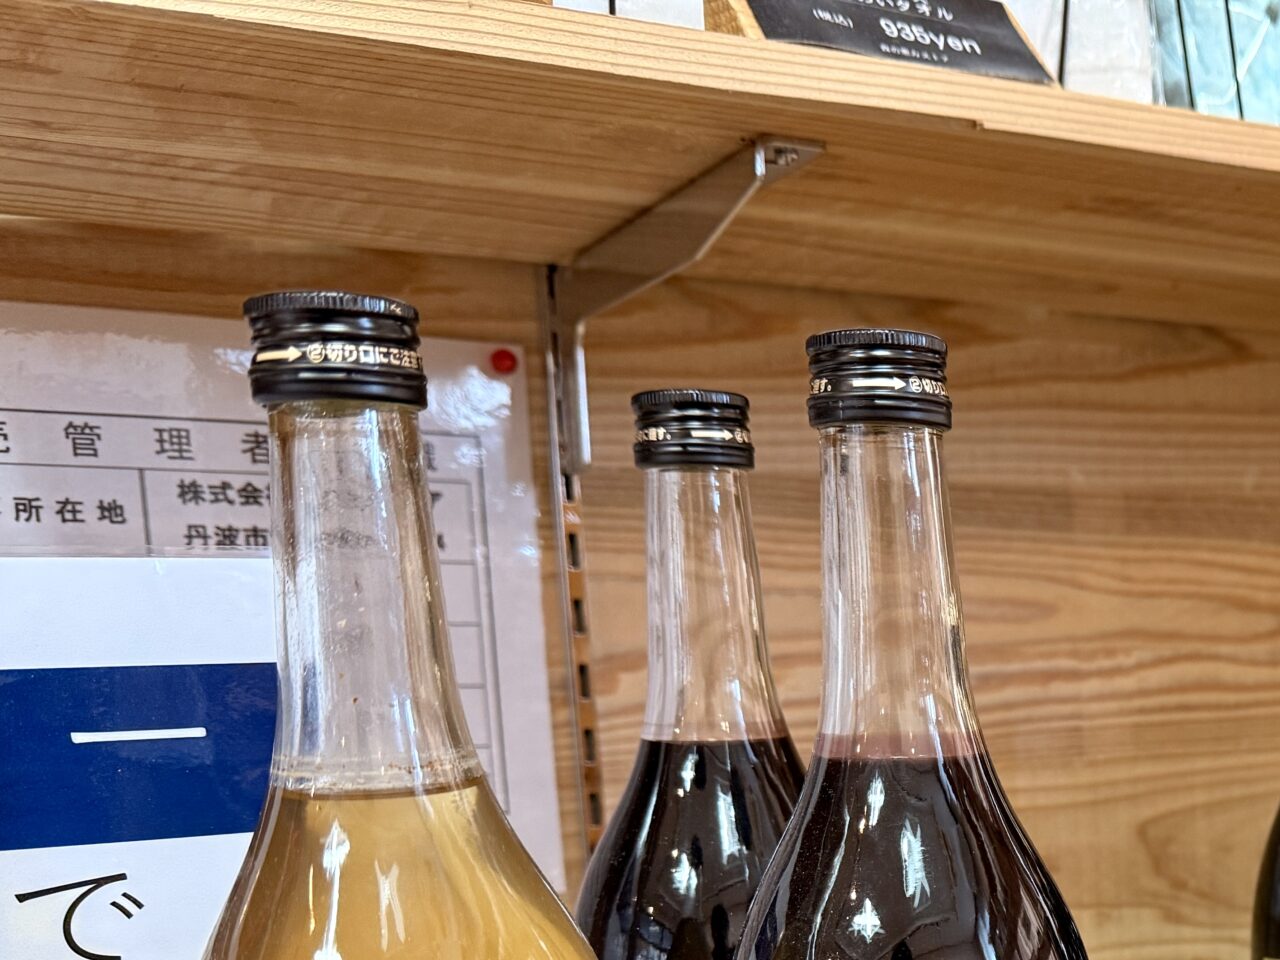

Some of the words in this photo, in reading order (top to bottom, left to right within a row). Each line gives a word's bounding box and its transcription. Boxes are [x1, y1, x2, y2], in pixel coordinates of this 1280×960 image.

[879, 17, 982, 56] 935yen
[176, 478, 271, 507] 株式会
[0, 496, 127, 525] 所在地
